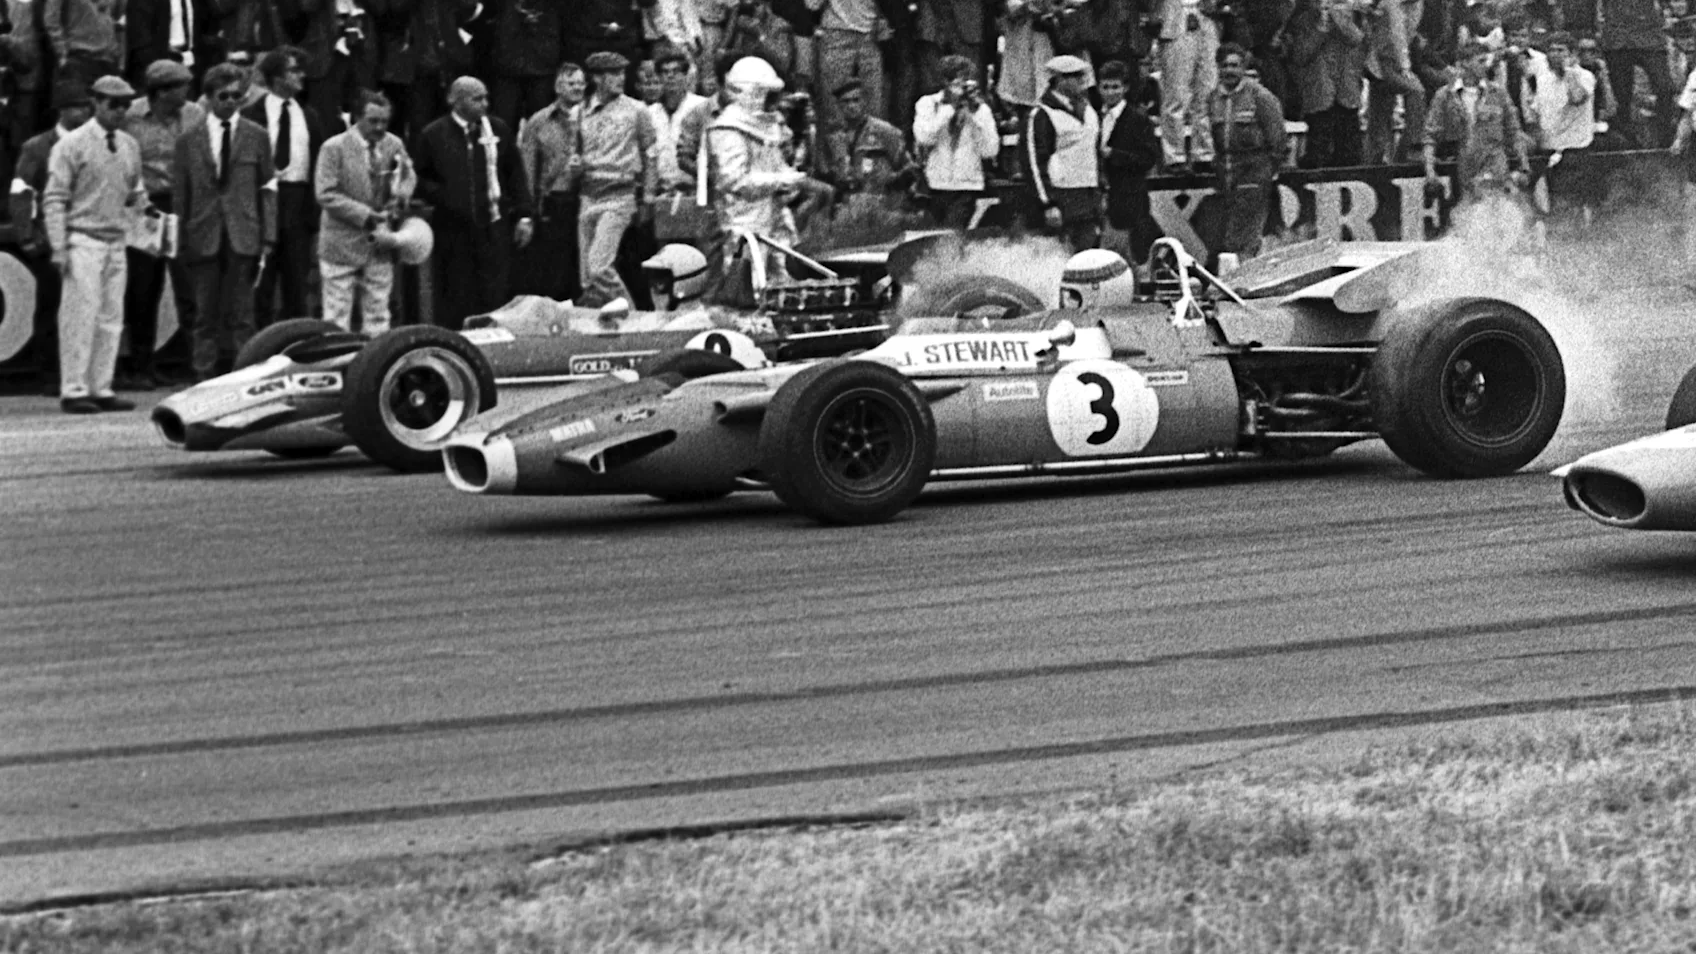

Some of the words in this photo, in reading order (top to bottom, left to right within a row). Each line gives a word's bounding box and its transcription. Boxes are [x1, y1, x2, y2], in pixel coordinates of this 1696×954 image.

[574, 359, 611, 374] GOLD
[897, 351, 918, 367] J.
[924, 340, 1030, 365] STEWART
[1077, 371, 1120, 446] 3
